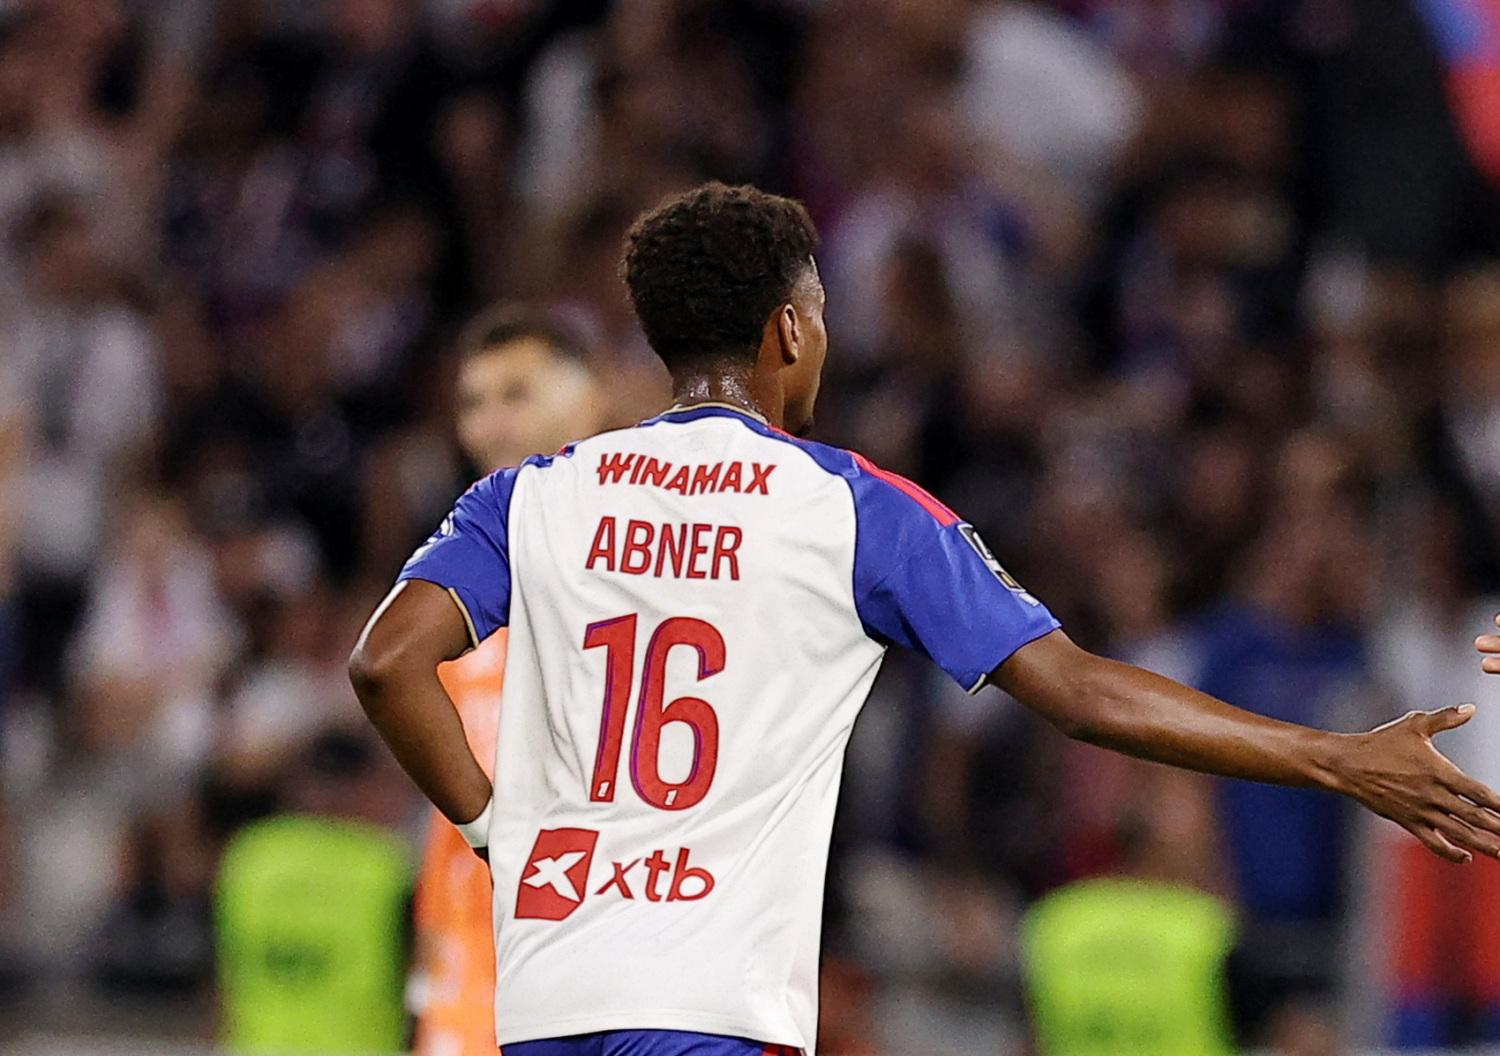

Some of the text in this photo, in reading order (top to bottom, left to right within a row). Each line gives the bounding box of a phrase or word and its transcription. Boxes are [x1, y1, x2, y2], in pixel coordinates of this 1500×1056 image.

[596, 452, 777, 496] WINAMAX
[585, 515, 743, 581] ABNER
[583, 612, 727, 811] 16
[593, 846, 715, 902] xtb
